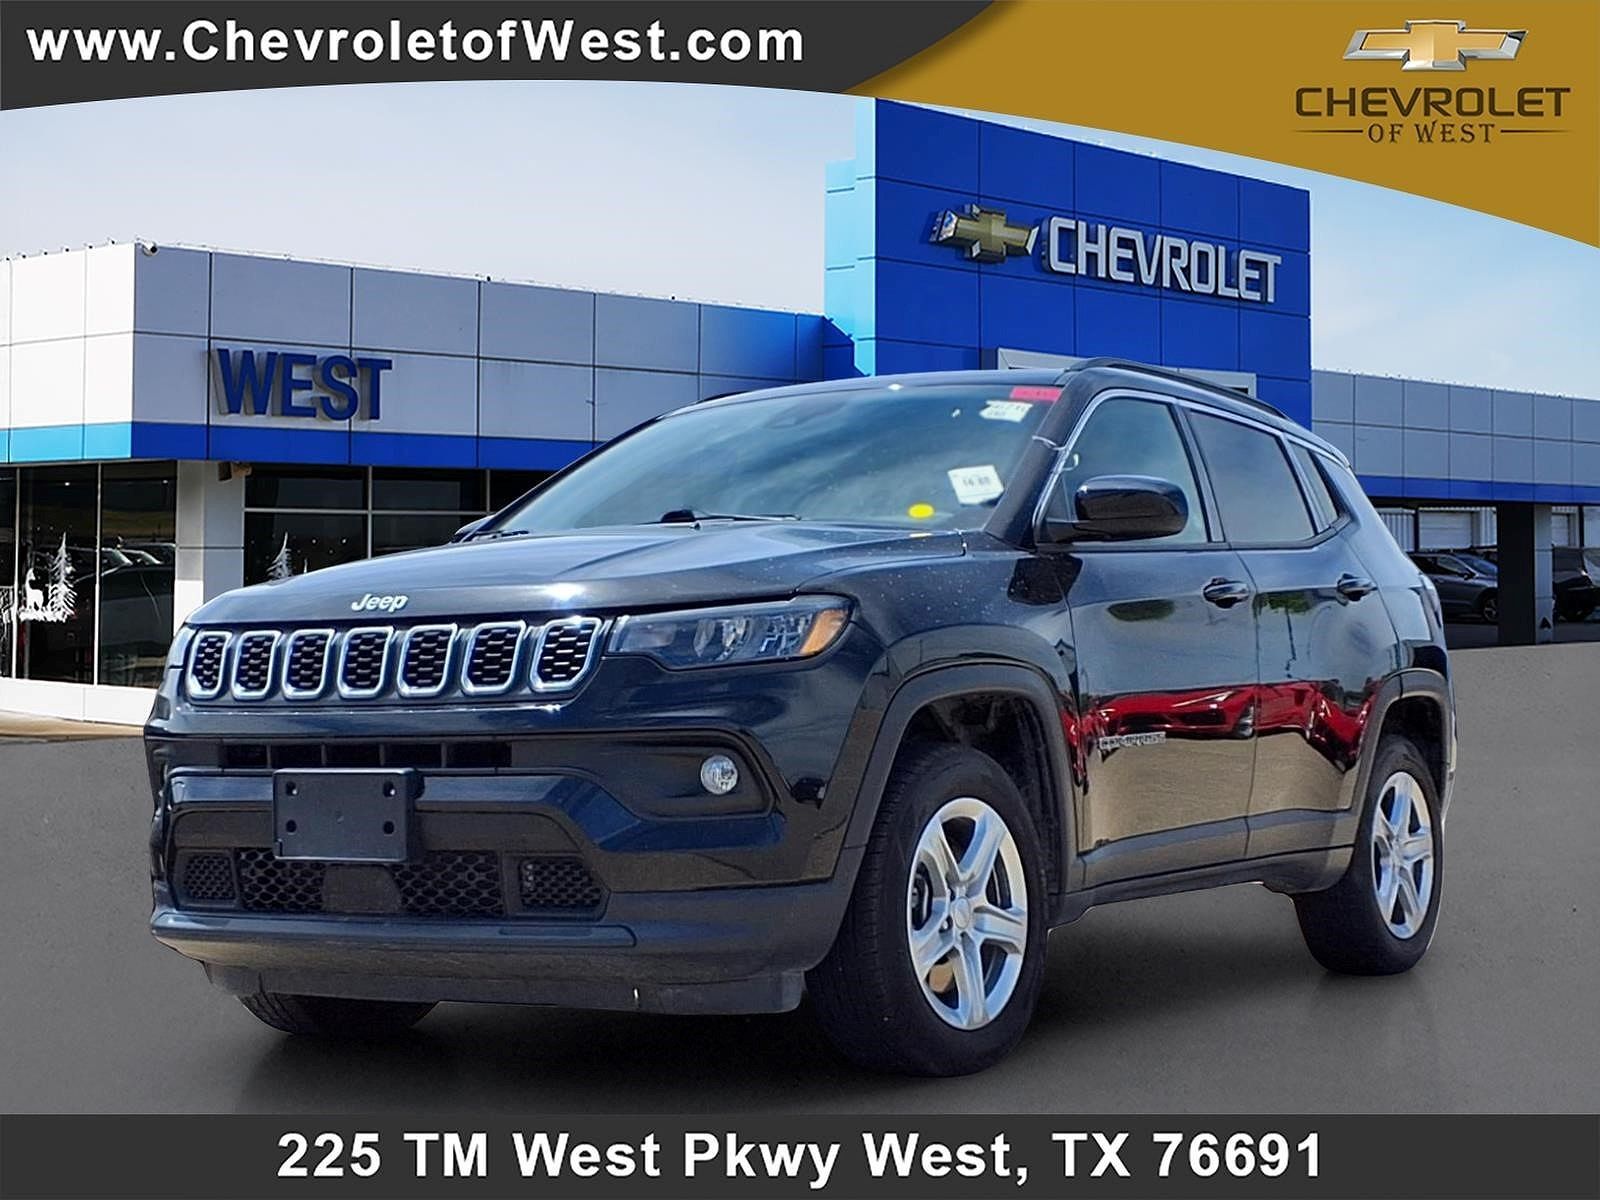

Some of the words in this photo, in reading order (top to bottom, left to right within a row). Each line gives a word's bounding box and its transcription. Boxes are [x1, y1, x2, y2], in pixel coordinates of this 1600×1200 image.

[1047, 215, 1281, 303] CHEVROLET
[216, 348, 393, 421] WEST
[351, 593, 409, 612] Jeep
